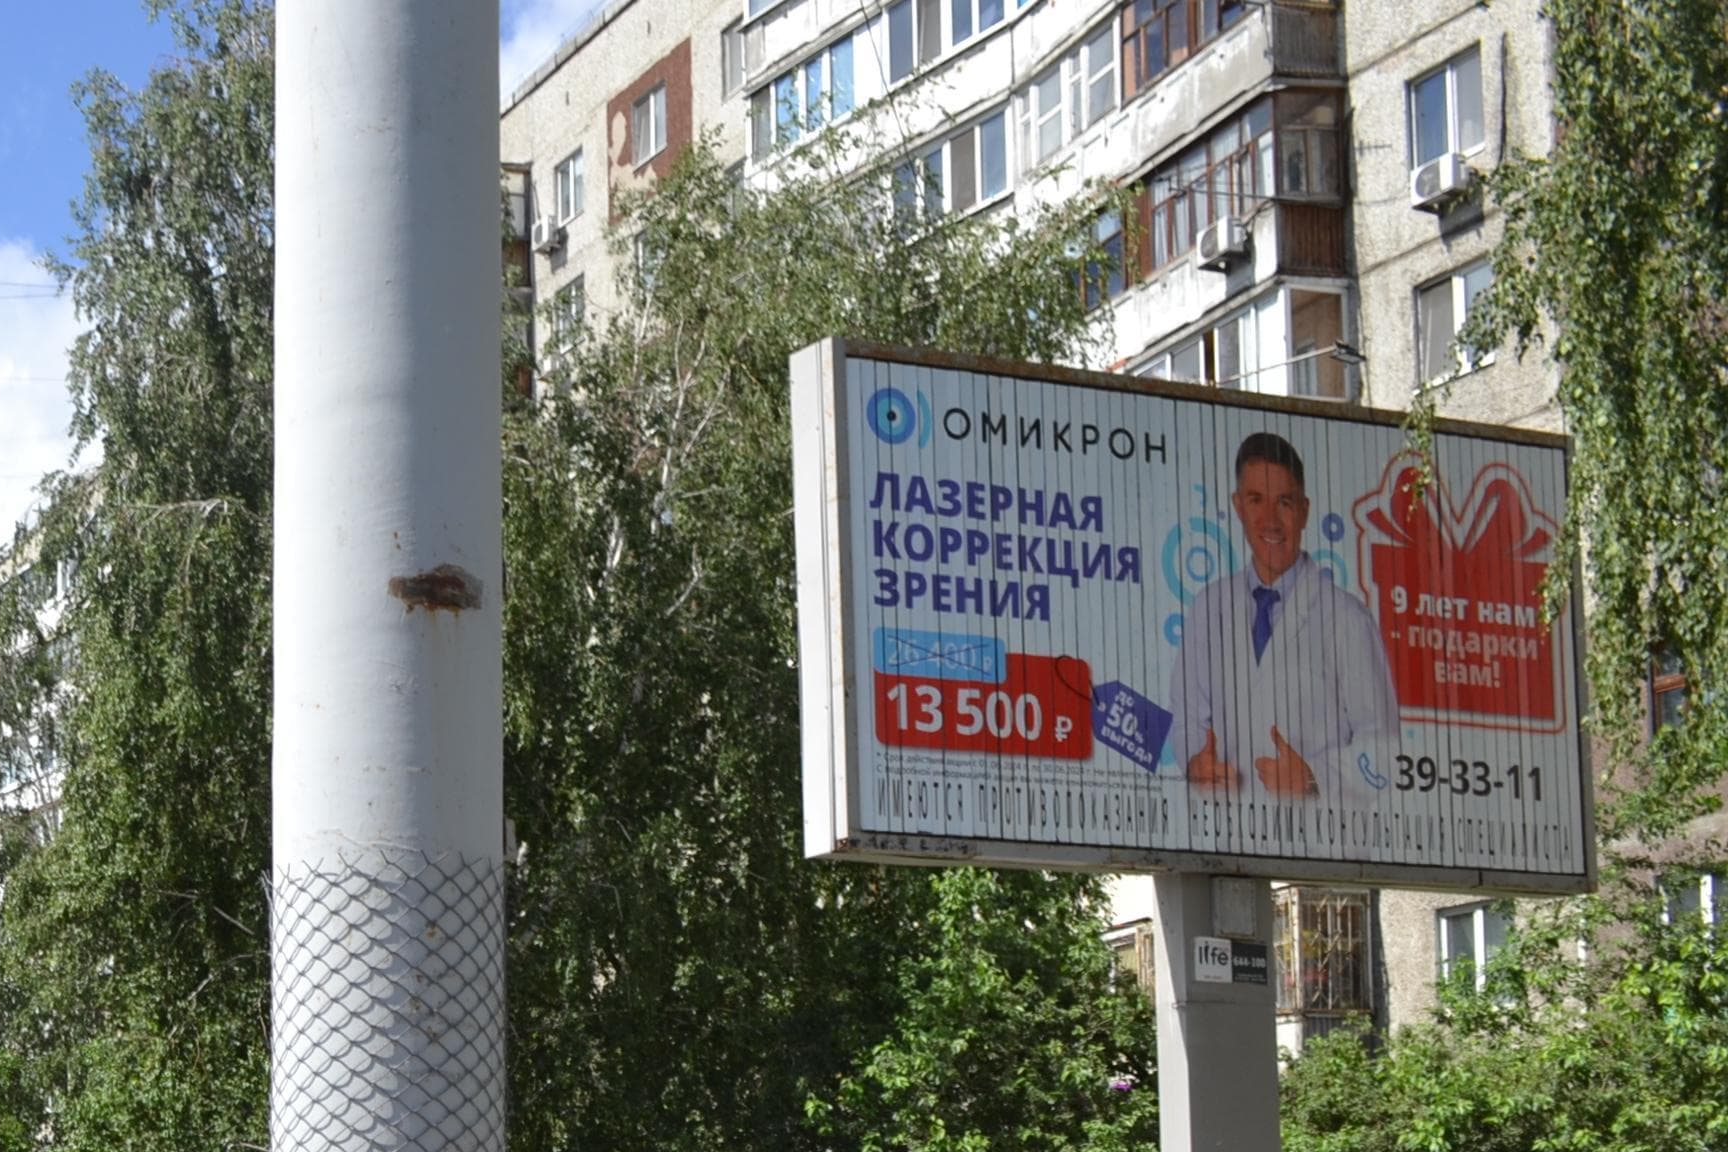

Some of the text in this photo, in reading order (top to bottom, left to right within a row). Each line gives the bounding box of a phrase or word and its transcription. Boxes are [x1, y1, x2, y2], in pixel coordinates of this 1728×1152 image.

[943, 407, 1167, 465] ОМИКРОН
[870, 471, 1104, 533] ЛАЗЕРНАЯ
[873, 519, 1141, 588] КОРРЕКЦИЯ
[874, 568, 1050, 622] ЗРЕНИЯ
[1391, 585, 1536, 628] 9 лет нам
[1407, 625, 1539, 664] подарки
[1434, 659, 1502, 689] вам!
[886, 682, 944, 734] 13
[955, 687, 1043, 742] 500
[1100, 724, 1153, 765] выгода
[1394, 753, 1544, 802] 39-33-11
[877, 776, 1571, 862] ИМЕЮТСЯ ПРОТИВОПОКАЗАНИЯ НЕОБХОДИМА КОНСУЛЬТАЦИЯ СПЕЦИАЛИСТА
[1198, 941, 1229, 966] life
